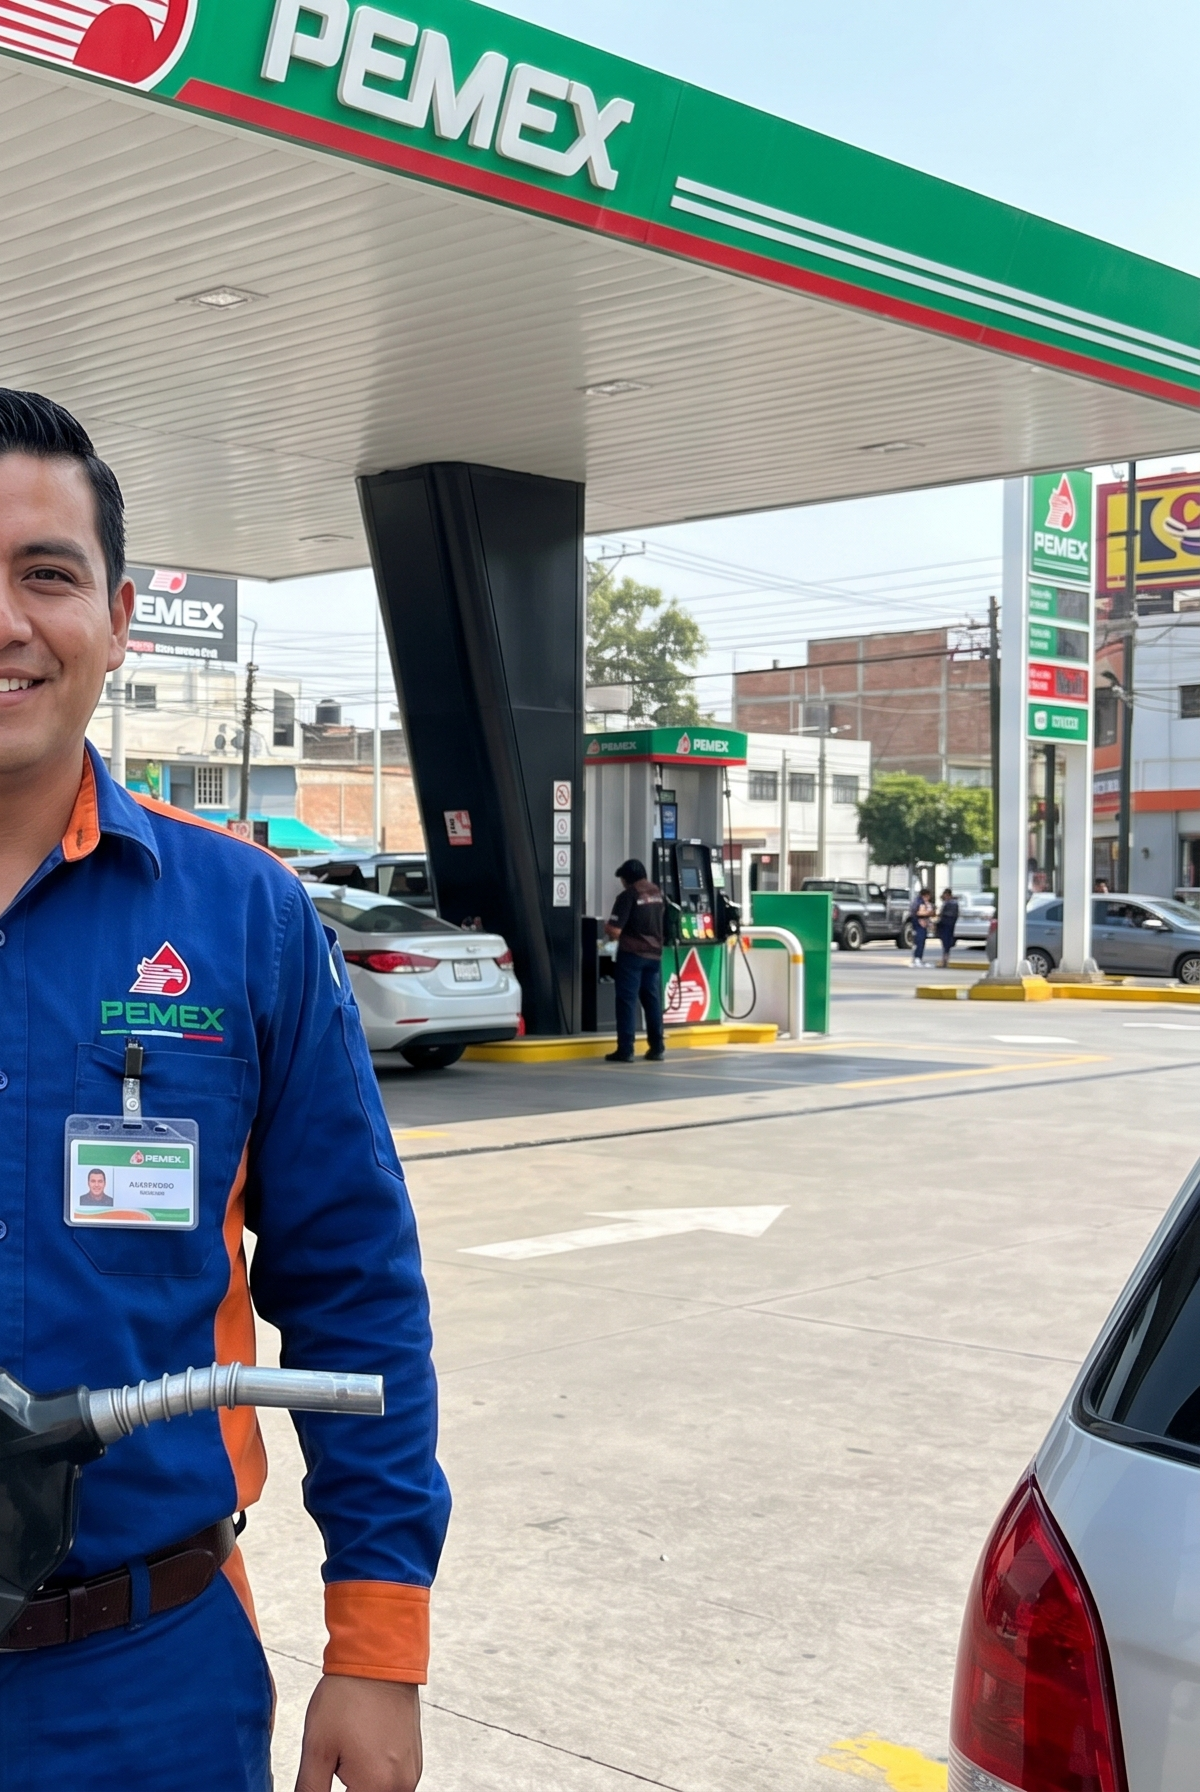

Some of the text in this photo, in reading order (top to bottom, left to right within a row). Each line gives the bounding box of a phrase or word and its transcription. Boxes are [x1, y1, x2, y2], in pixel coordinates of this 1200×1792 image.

[260, 0, 635, 191] PEMEX
[1034, 531, 1089, 562] PEMEX
[135, 593, 225, 631] EMEX
[601, 741, 637, 751] PEMEX
[693, 738, 729, 753] PEMEX
[101, 1000, 225, 1031] PEMEX
